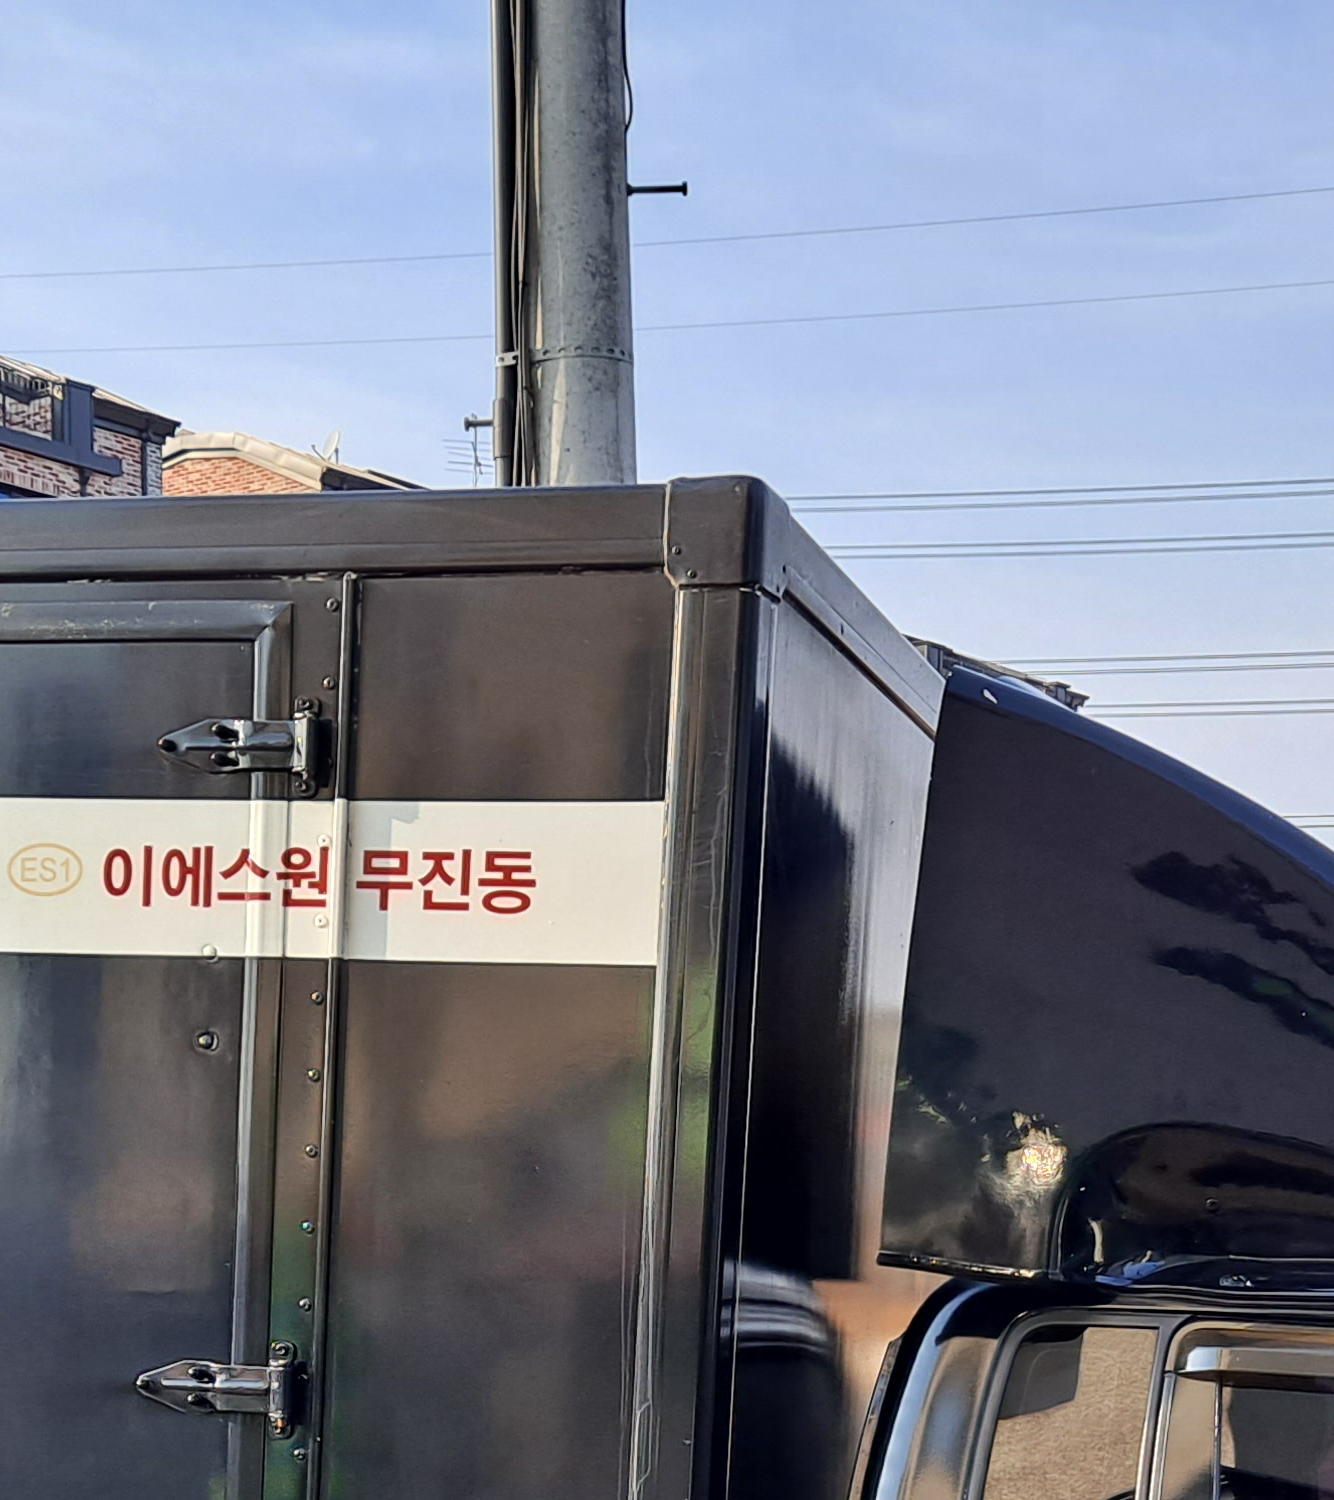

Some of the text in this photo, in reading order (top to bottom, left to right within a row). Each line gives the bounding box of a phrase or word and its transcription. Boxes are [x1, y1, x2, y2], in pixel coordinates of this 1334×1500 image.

[19, 856, 72, 883] ES1
[102, 845, 536, 914] 이에스원 무진동
